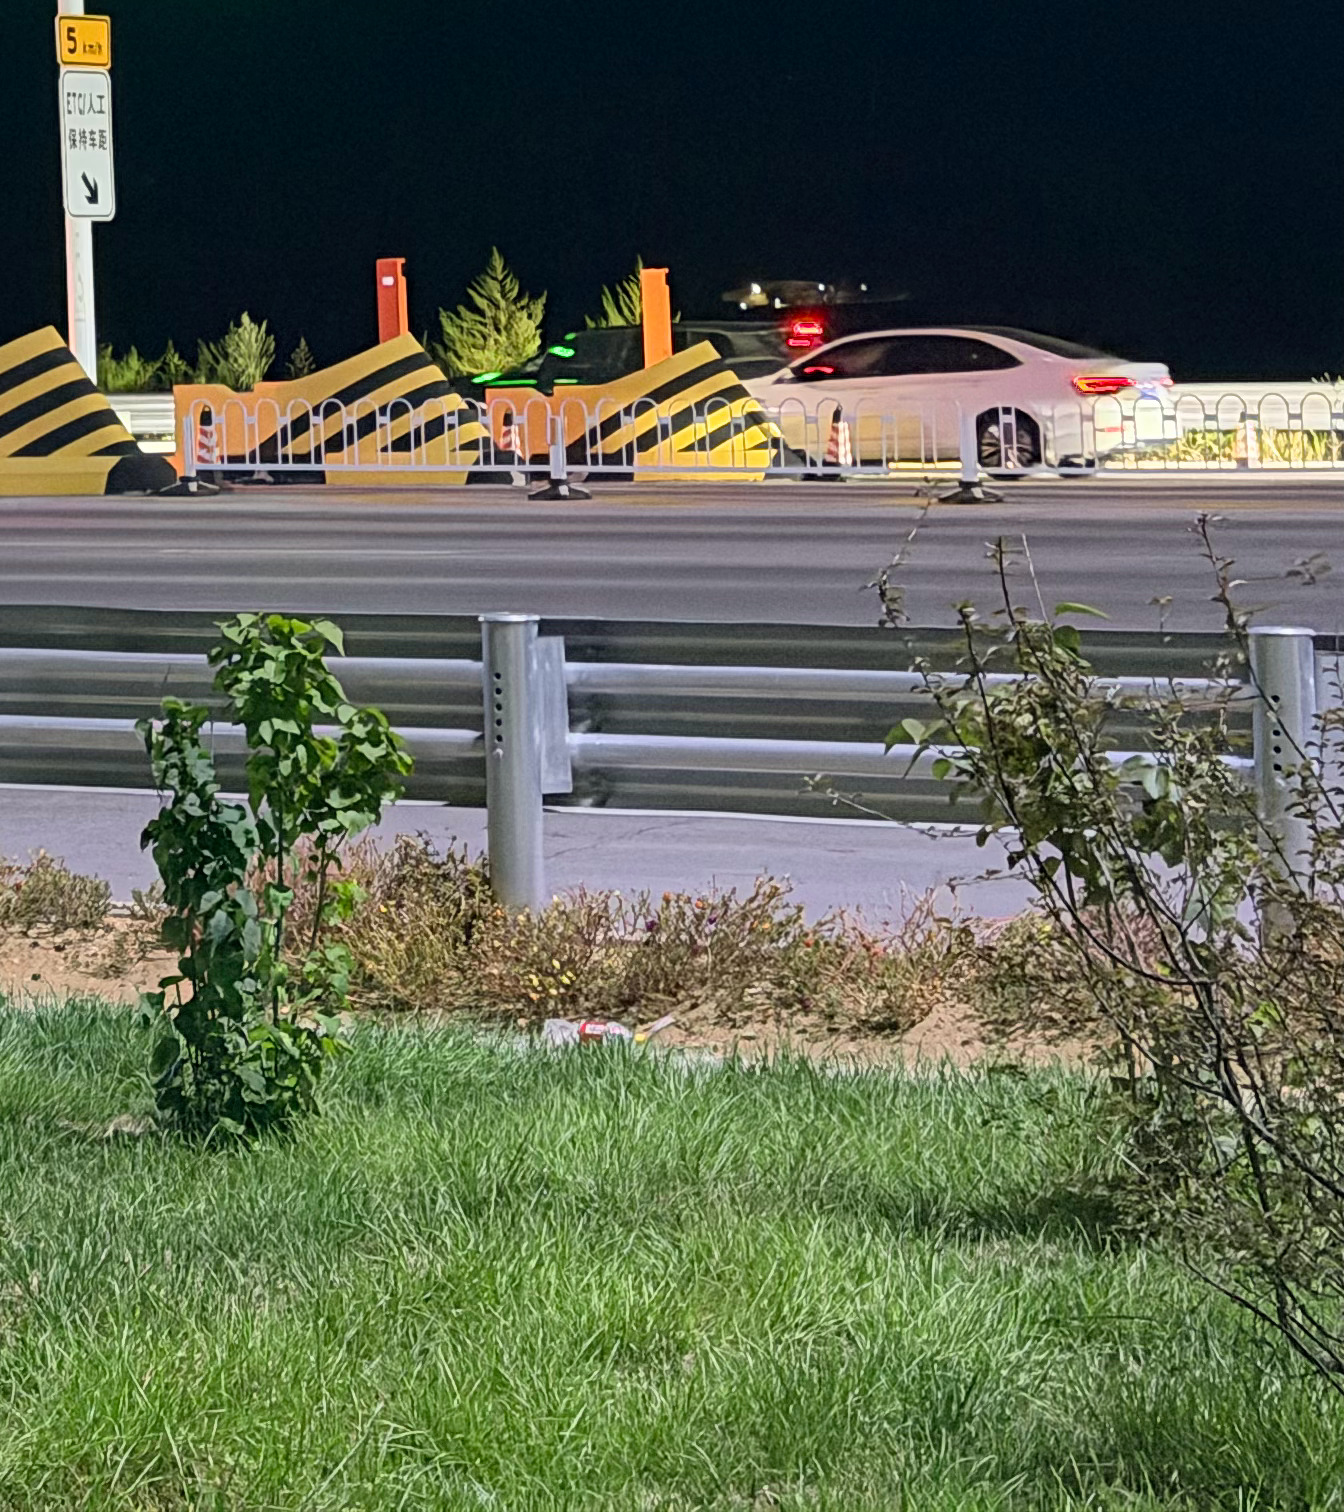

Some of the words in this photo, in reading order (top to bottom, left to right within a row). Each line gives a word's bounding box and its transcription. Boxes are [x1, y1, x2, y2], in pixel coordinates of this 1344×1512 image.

[66, 27, 76, 54] 5
[66, 91, 106, 116] ETC/人工
[69, 128, 107, 151] 保持车距
